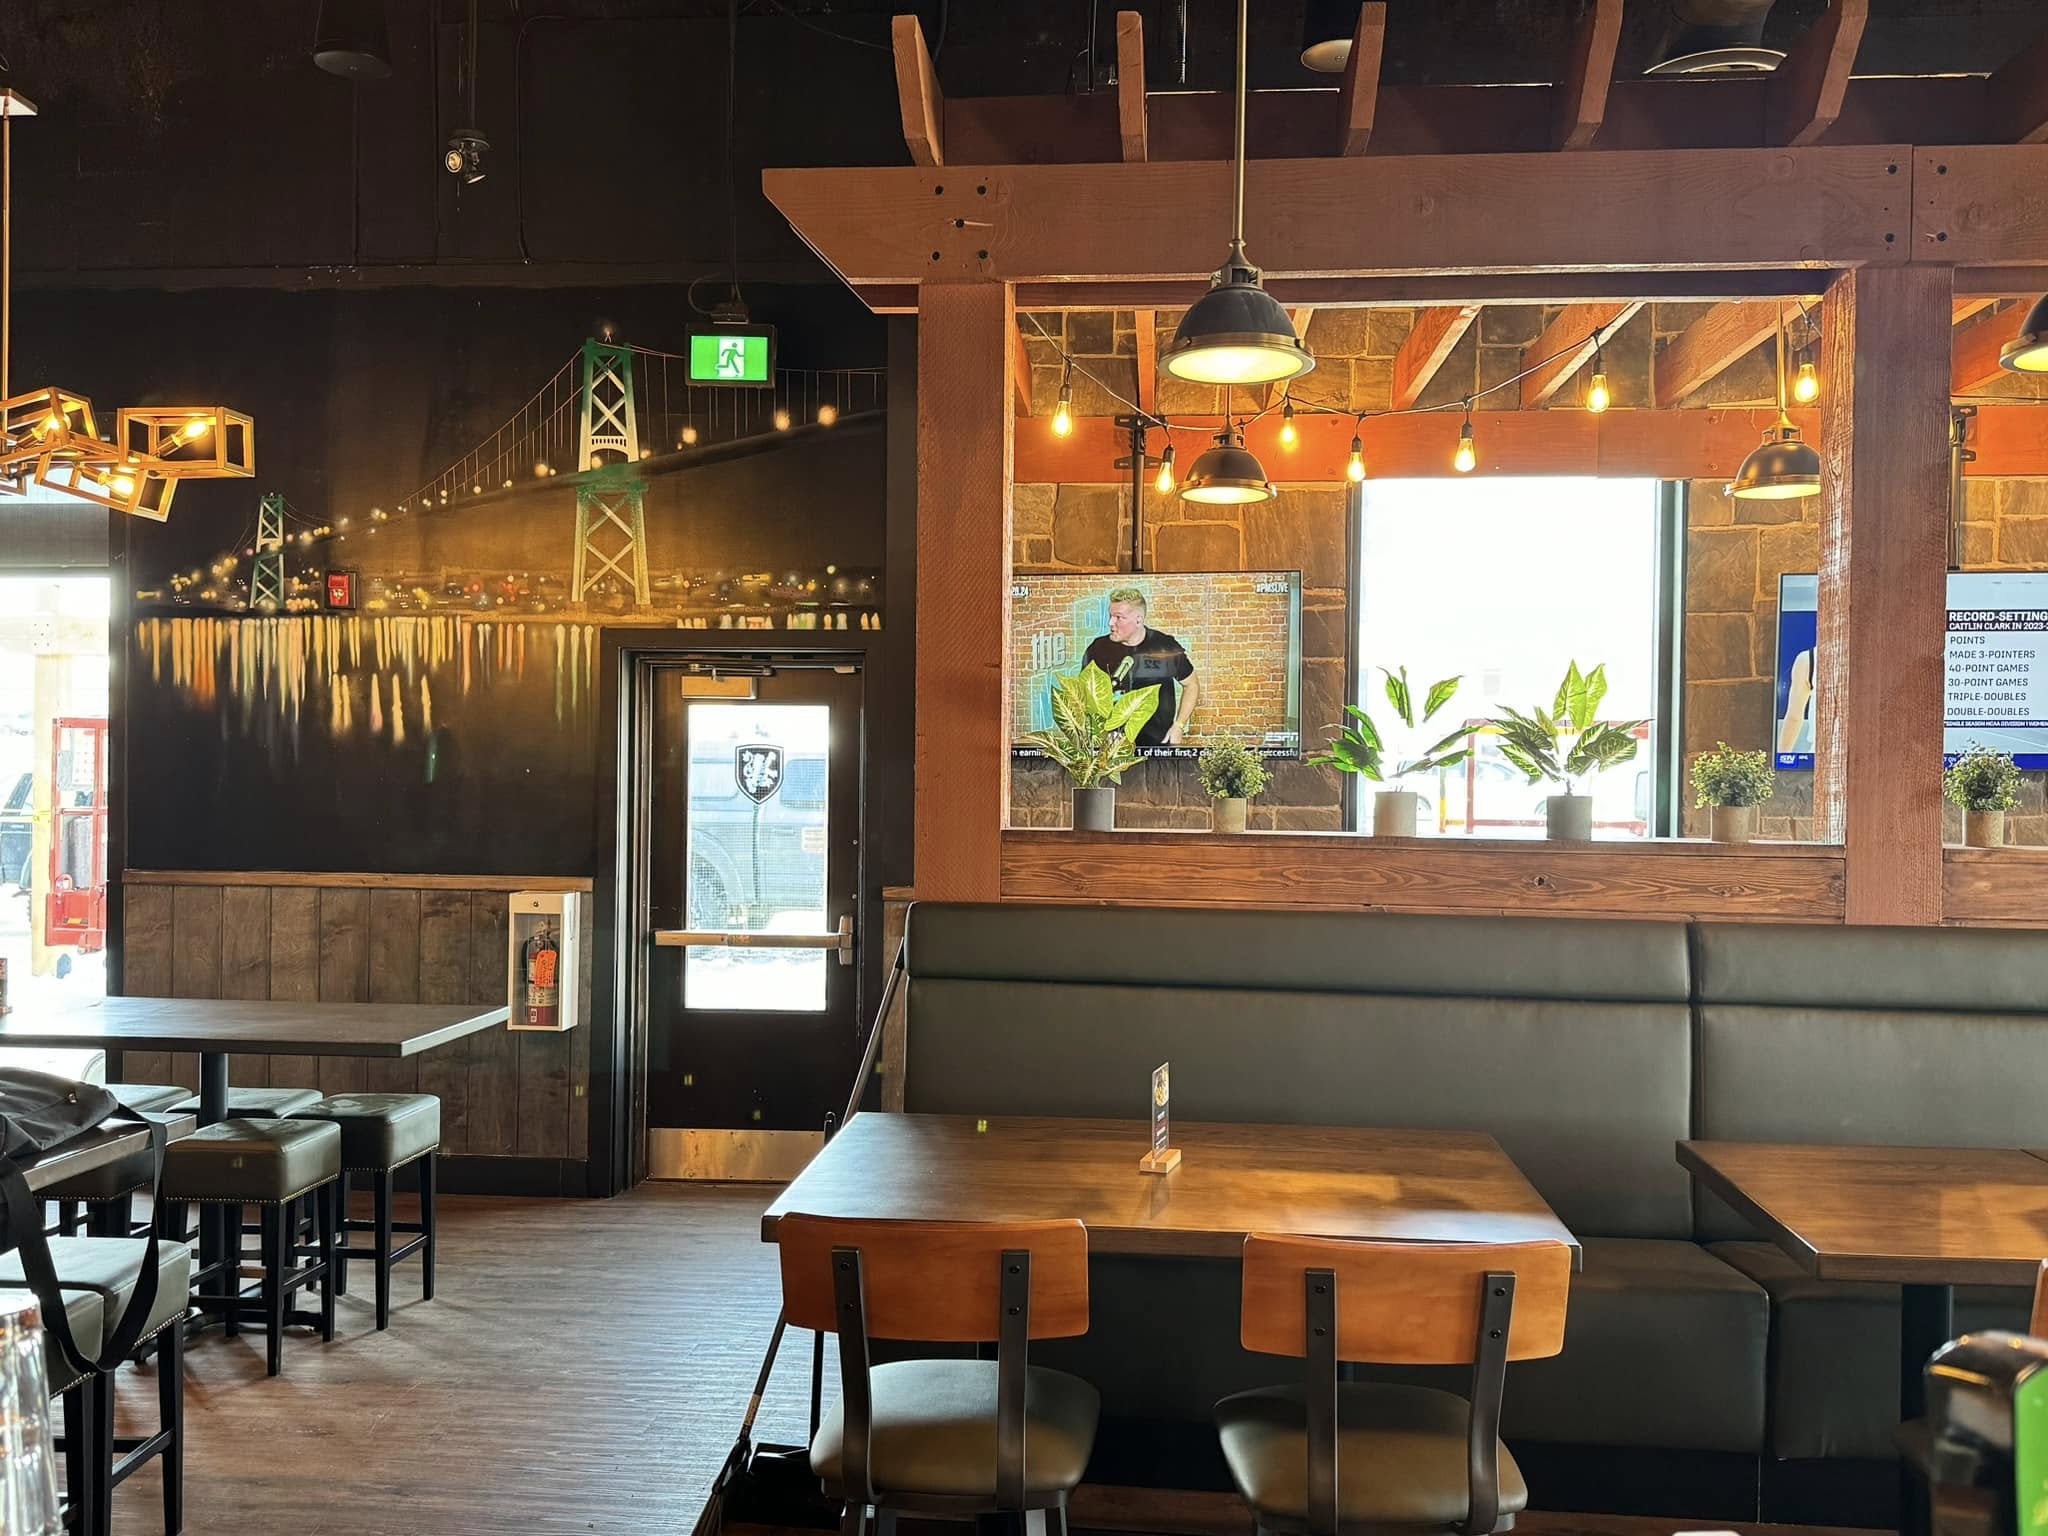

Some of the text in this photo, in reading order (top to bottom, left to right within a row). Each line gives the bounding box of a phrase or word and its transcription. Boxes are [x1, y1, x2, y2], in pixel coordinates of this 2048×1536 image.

[1948, 611, 2048, 622] RECORD-SETTING
[1949, 622, 1983, 630] CAITLIN
[1983, 622, 2011, 630] CLARK
[2011, 622, 2022, 630] IN
[1950, 635, 1986, 645] POINTS
[1949, 650, 2036, 659] MADE 3-POINTERS
[1948, 664, 2030, 673] 40-POINT GAMES
[1947, 678, 2029, 687] 30-POINT GAMES
[1947, 692, 2027, 701] TRIPLE-DOUBLES
[1946, 707, 2030, 716] DOUBLE-DOUBLES
[1143, 748, 1153, 757] of
[1154, 748, 1174, 757] their
